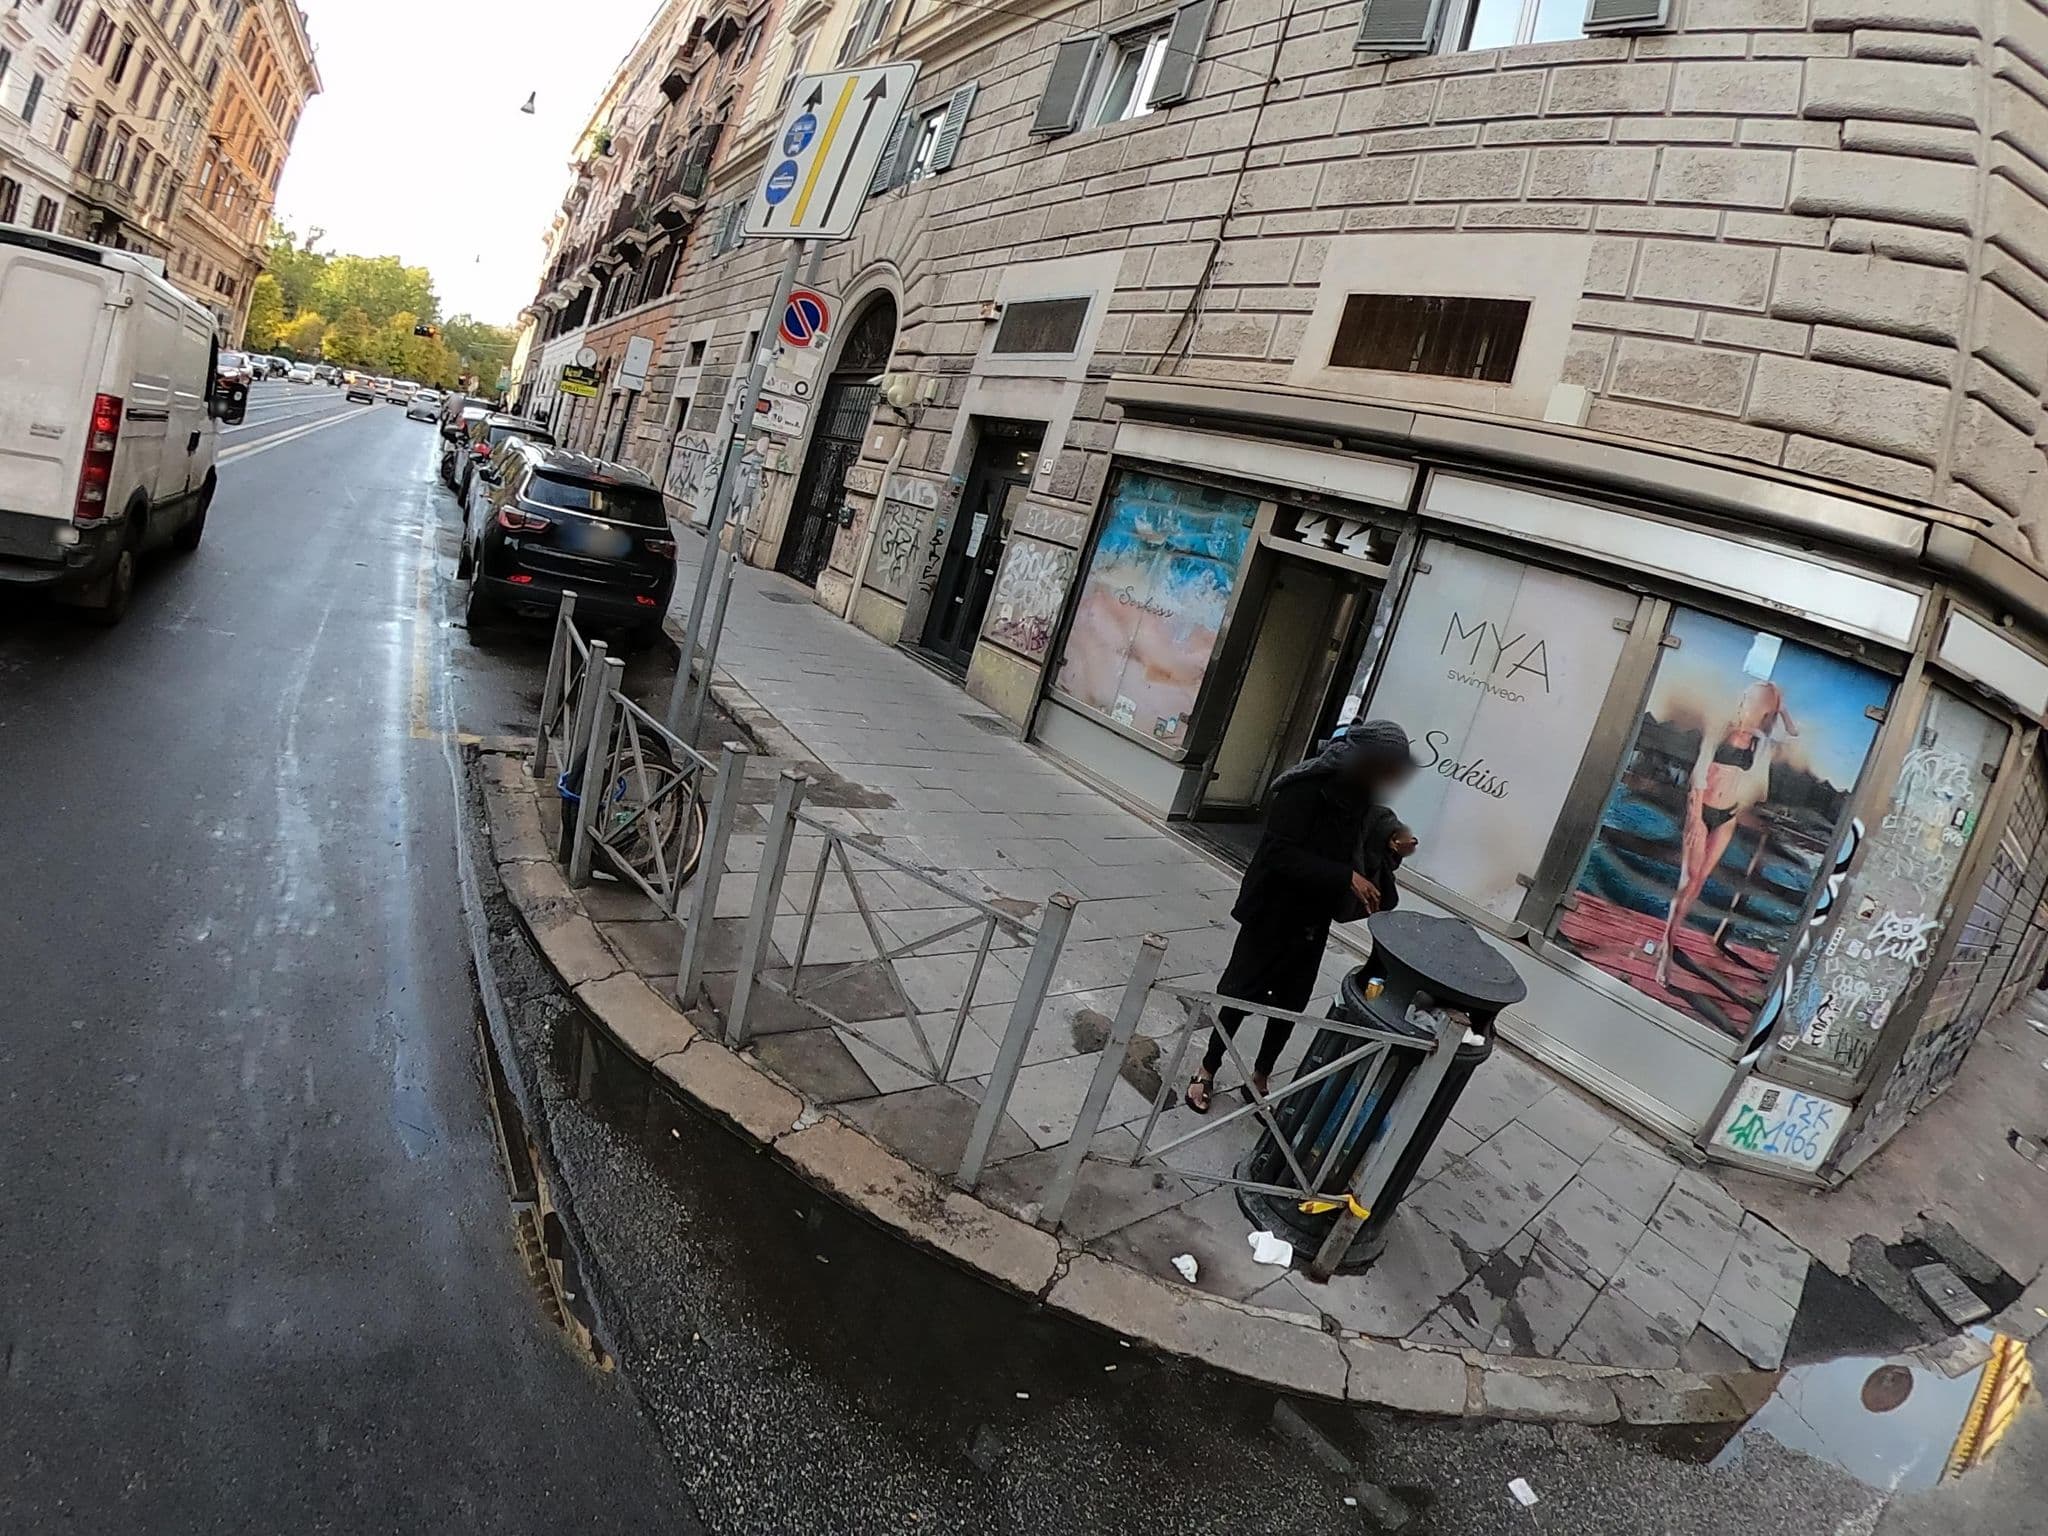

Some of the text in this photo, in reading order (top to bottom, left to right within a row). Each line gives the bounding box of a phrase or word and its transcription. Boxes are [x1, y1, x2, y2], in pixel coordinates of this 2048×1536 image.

[1294, 509, 1371, 560] 44
[1440, 611, 1549, 694] MYA
[1447, 668, 1525, 703] swimwear
[1409, 730, 1509, 799] Sexkiss
